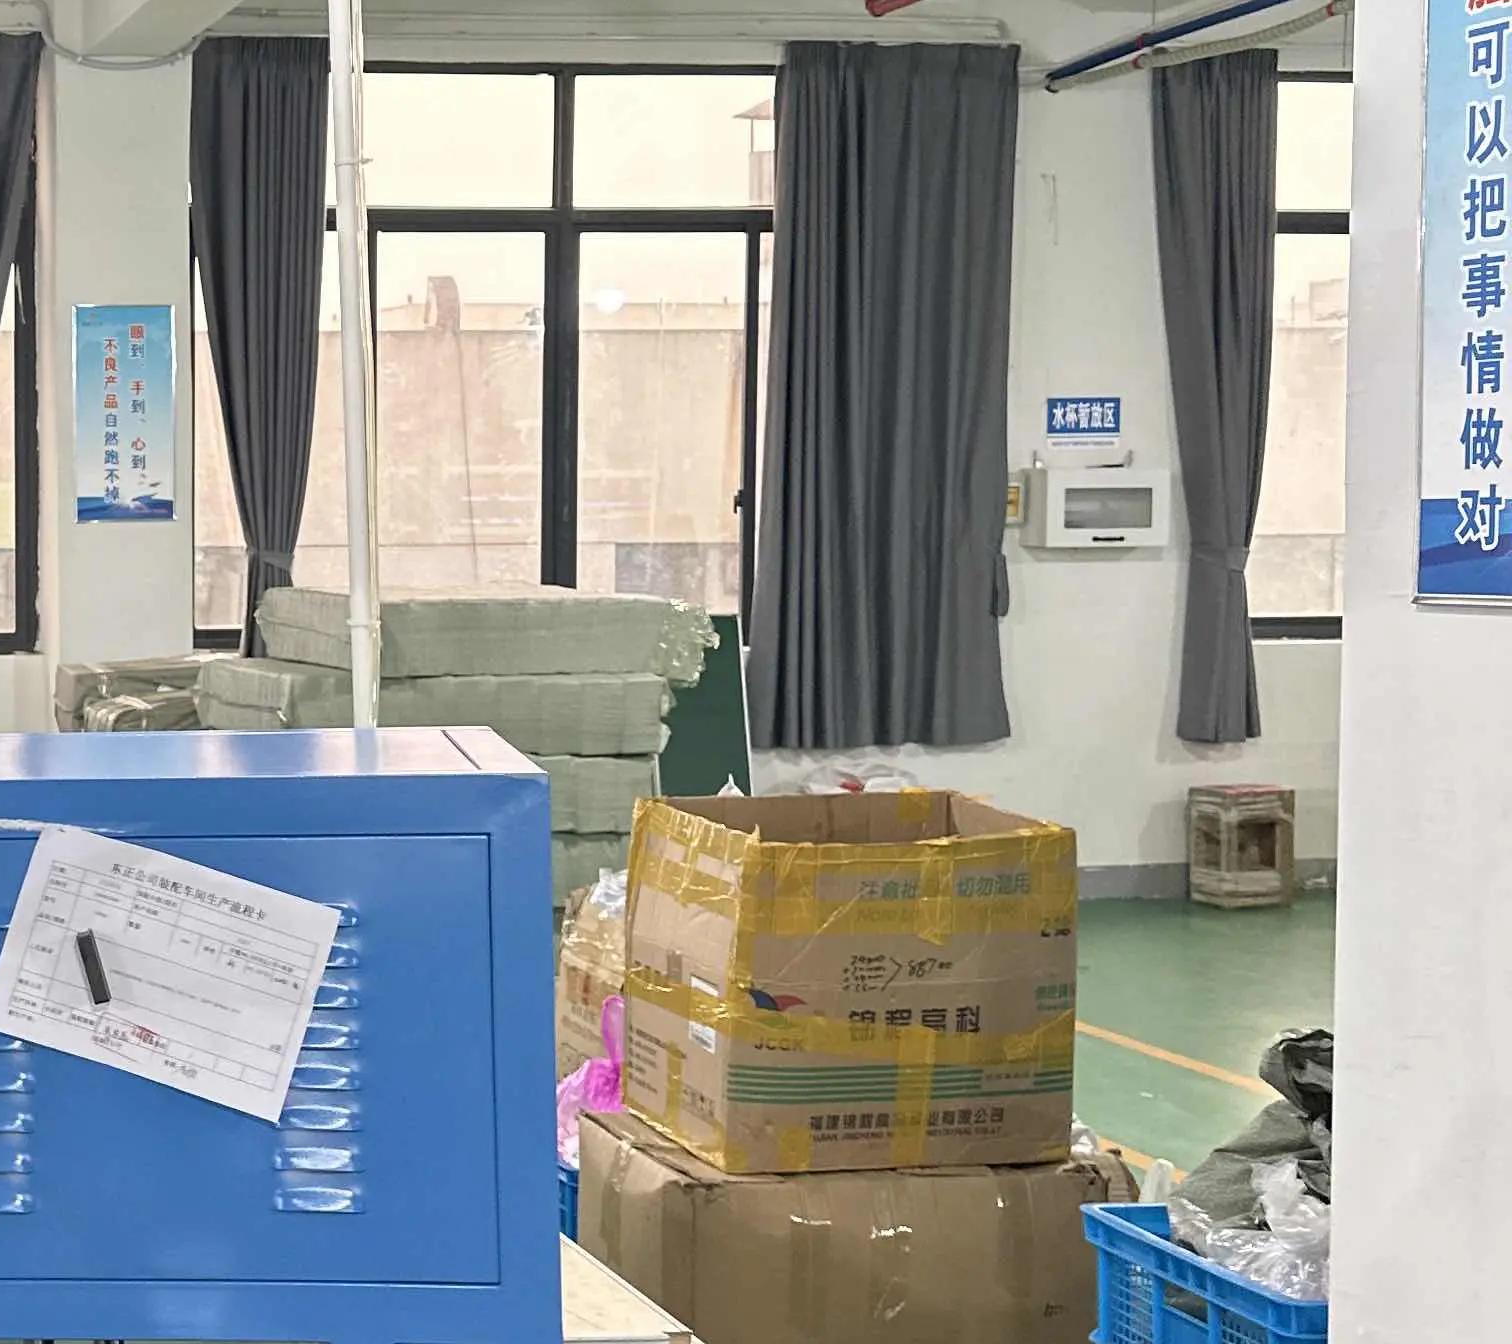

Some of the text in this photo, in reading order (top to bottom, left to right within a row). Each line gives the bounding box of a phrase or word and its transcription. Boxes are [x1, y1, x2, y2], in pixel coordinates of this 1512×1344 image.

[104, 338, 120, 503] 不良产品自然跑不掉
[1052, 402, 1116, 429] 水杯暂放区
